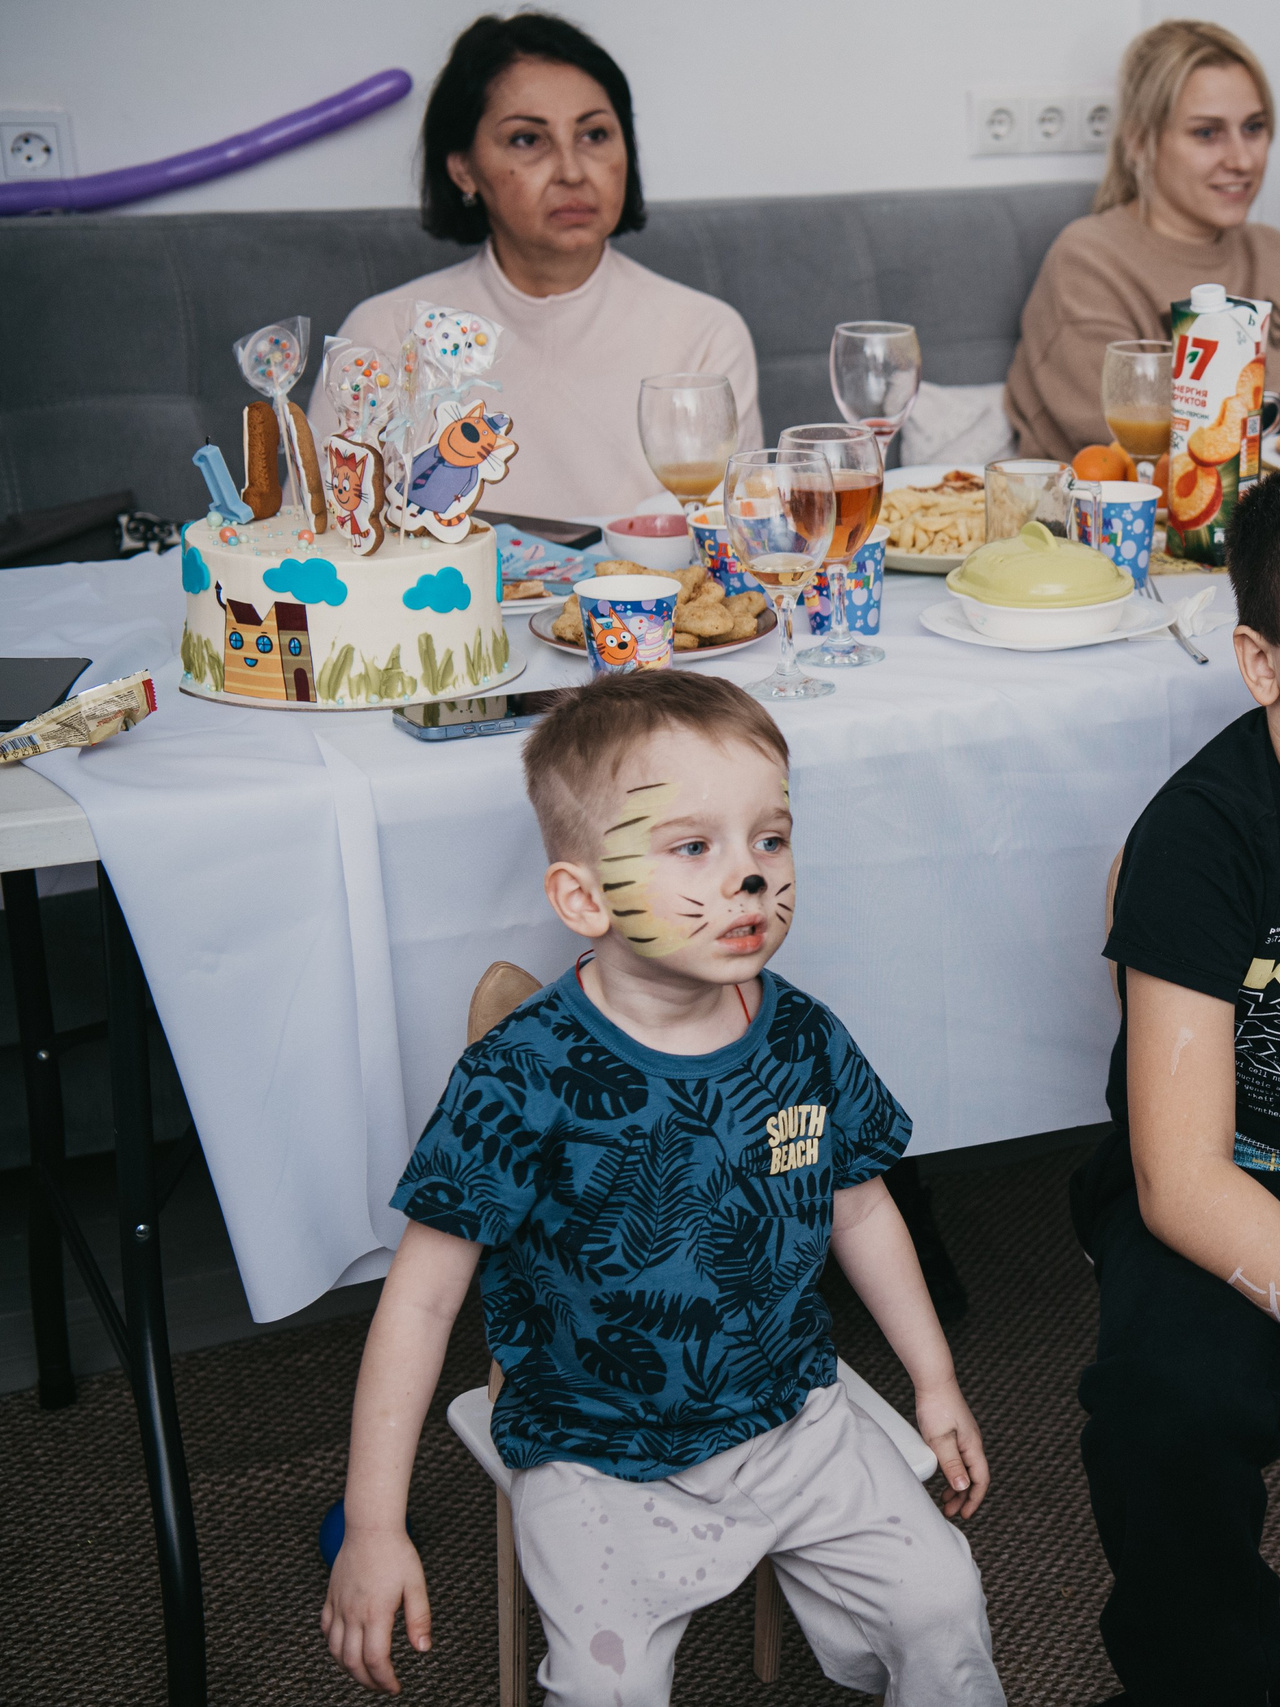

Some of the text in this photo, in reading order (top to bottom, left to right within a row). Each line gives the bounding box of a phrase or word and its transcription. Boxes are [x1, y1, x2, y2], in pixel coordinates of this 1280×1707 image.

[1172, 384, 1208, 398] НЕРГИЯ
[1172, 392, 1207, 408] РУКТОВ
[704, 539, 715, 556] С
[1248, 1066, 1268, 1078] cell
[766, 1104, 827, 1148] SOUTH
[769, 1137, 819, 1176] BEACH
